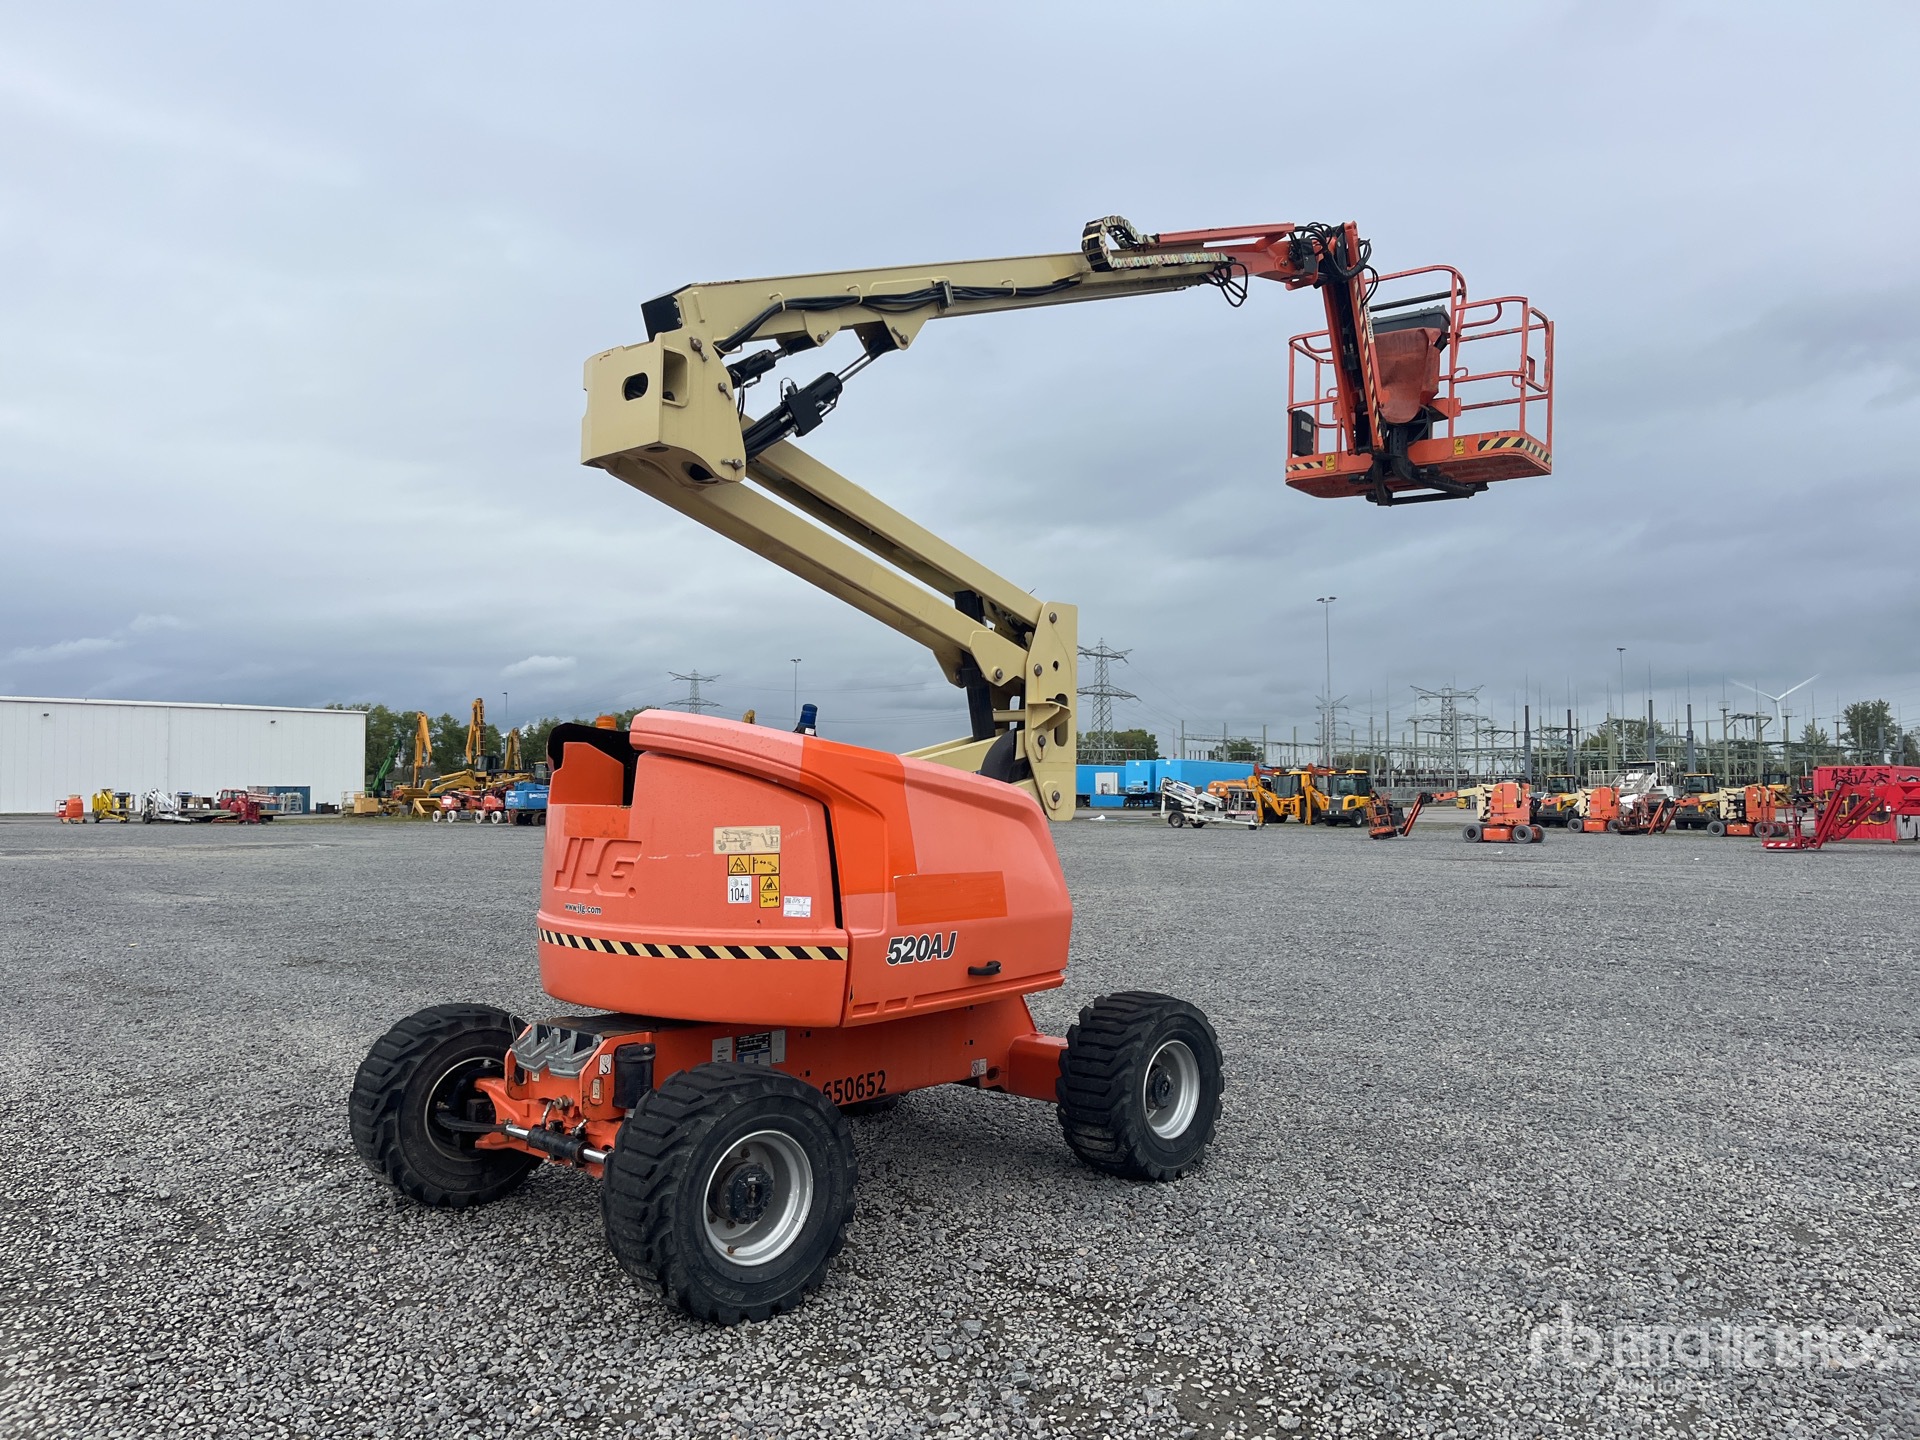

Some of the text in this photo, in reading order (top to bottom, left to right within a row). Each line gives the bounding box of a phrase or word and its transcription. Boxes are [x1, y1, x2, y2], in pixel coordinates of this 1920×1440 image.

[553, 836, 642, 897] JLG
[564, 903, 602, 915] www.jlg.com
[730, 888, 745, 901] 104
[885, 931, 957, 966] 520AJ
[822, 1070, 887, 1104] 650652
